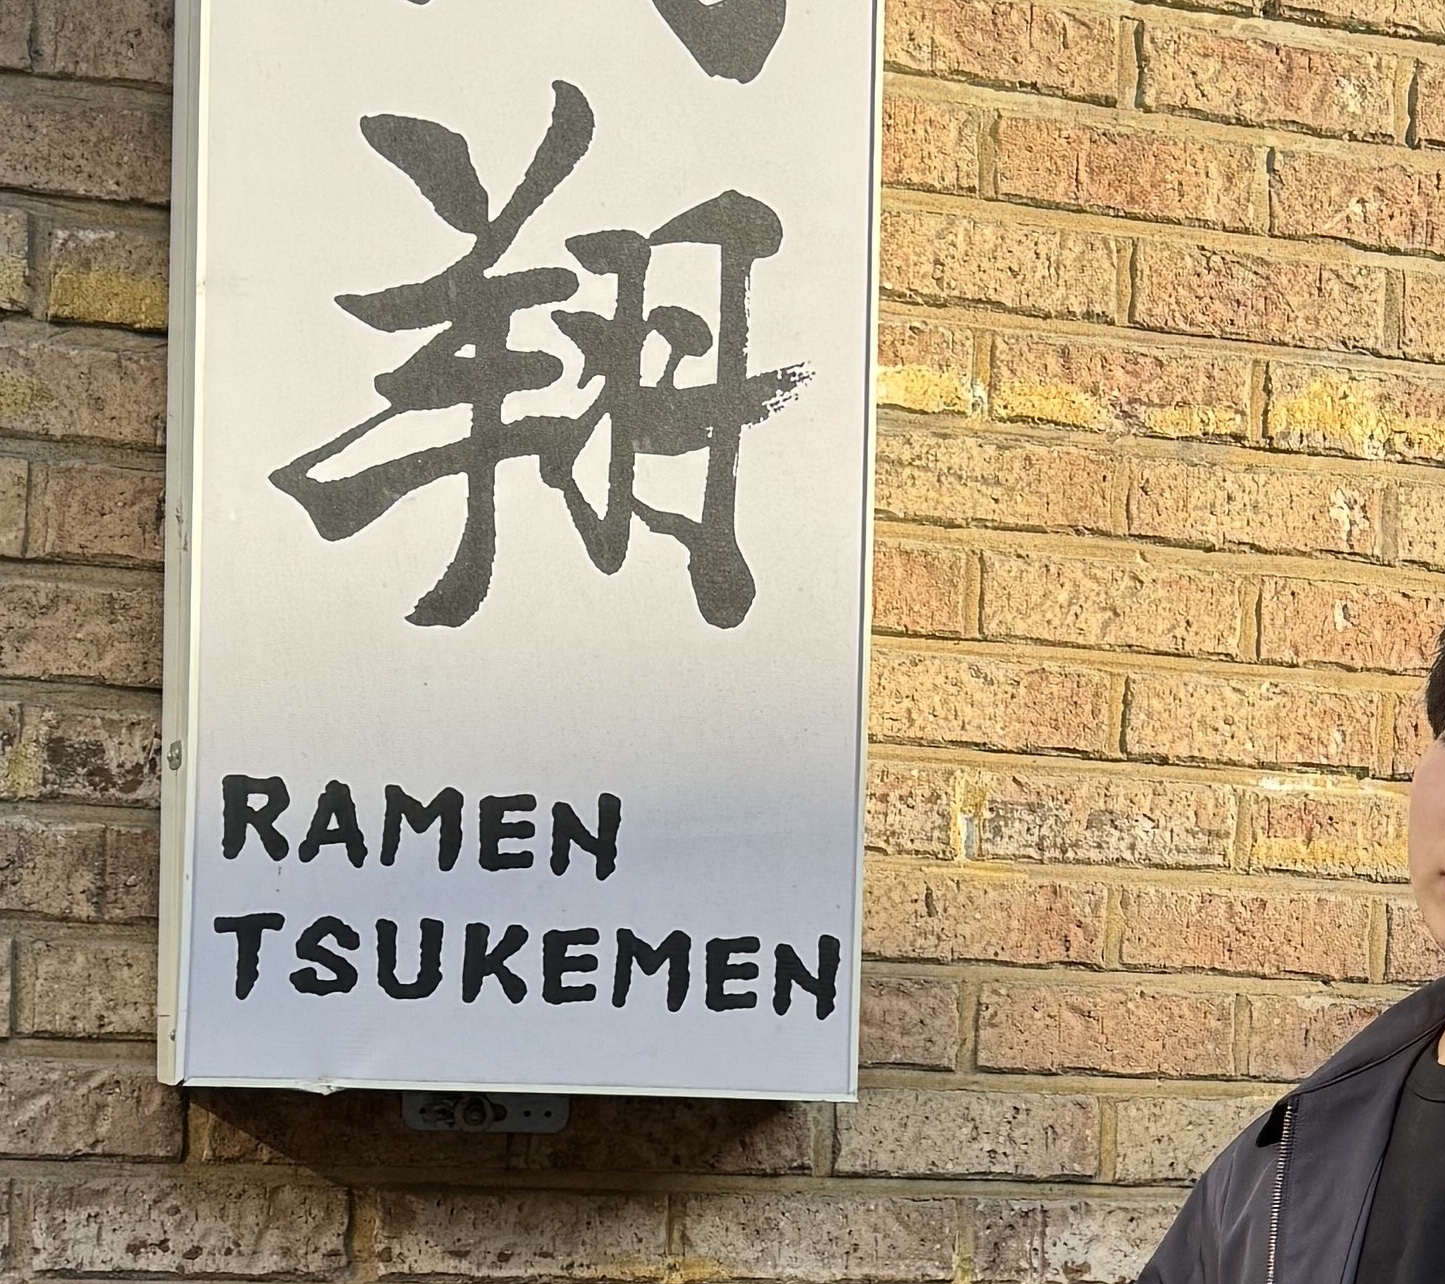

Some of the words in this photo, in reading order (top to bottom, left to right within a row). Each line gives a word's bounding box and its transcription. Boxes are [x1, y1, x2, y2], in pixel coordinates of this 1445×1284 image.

[268, 0, 816, 630] 翔
[221, 774, 622, 882] RAMEN
[213, 912, 841, 1021] TSUKEMEN
